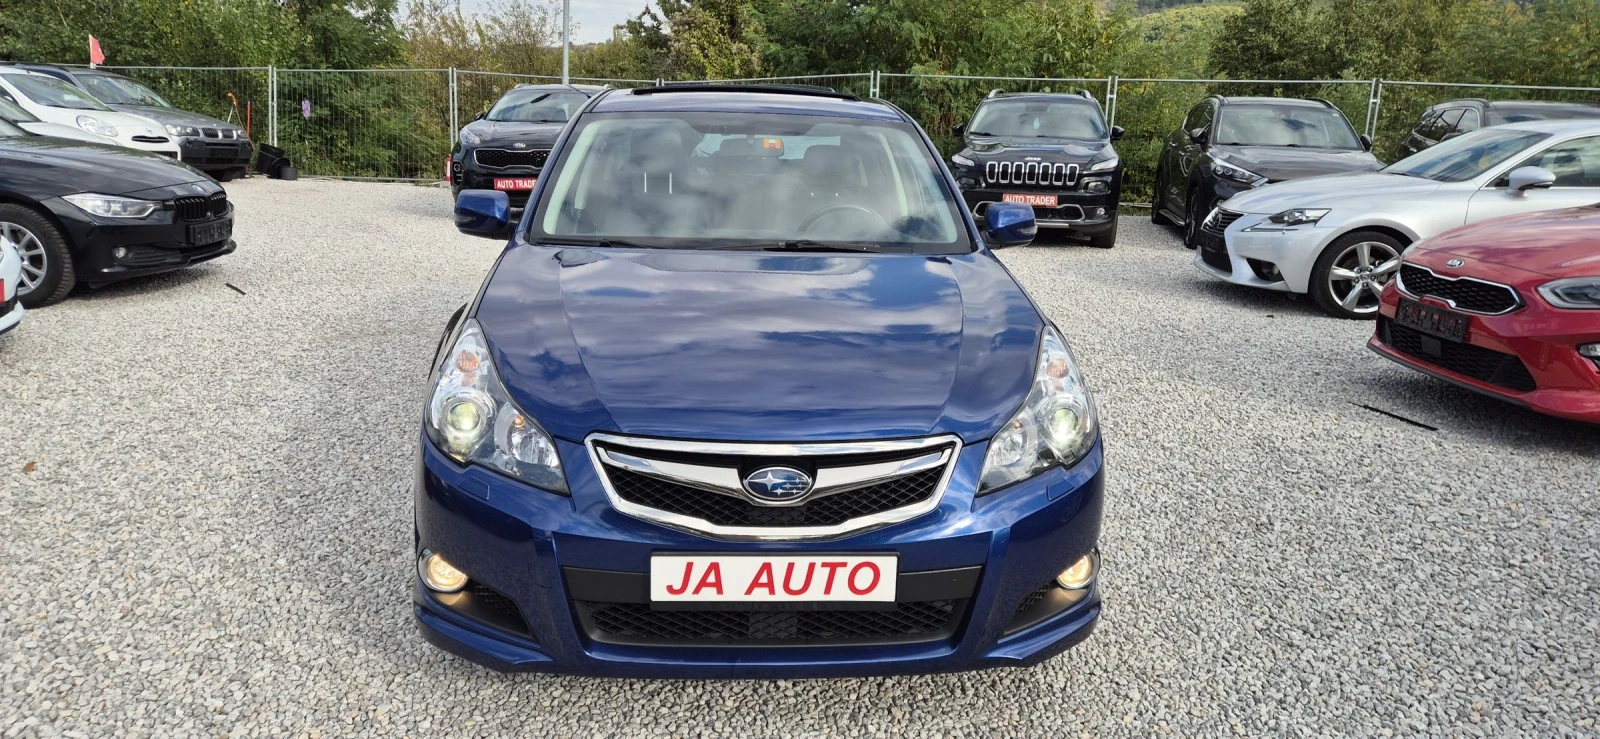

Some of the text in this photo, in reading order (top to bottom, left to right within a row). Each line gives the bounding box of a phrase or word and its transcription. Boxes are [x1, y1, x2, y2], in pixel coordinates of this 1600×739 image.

[497, 180, 537, 188] AUTO TRADE
[1005, 195, 1055, 205] AUTO TRADER
[666, 561, 881, 596] JA AUTO
